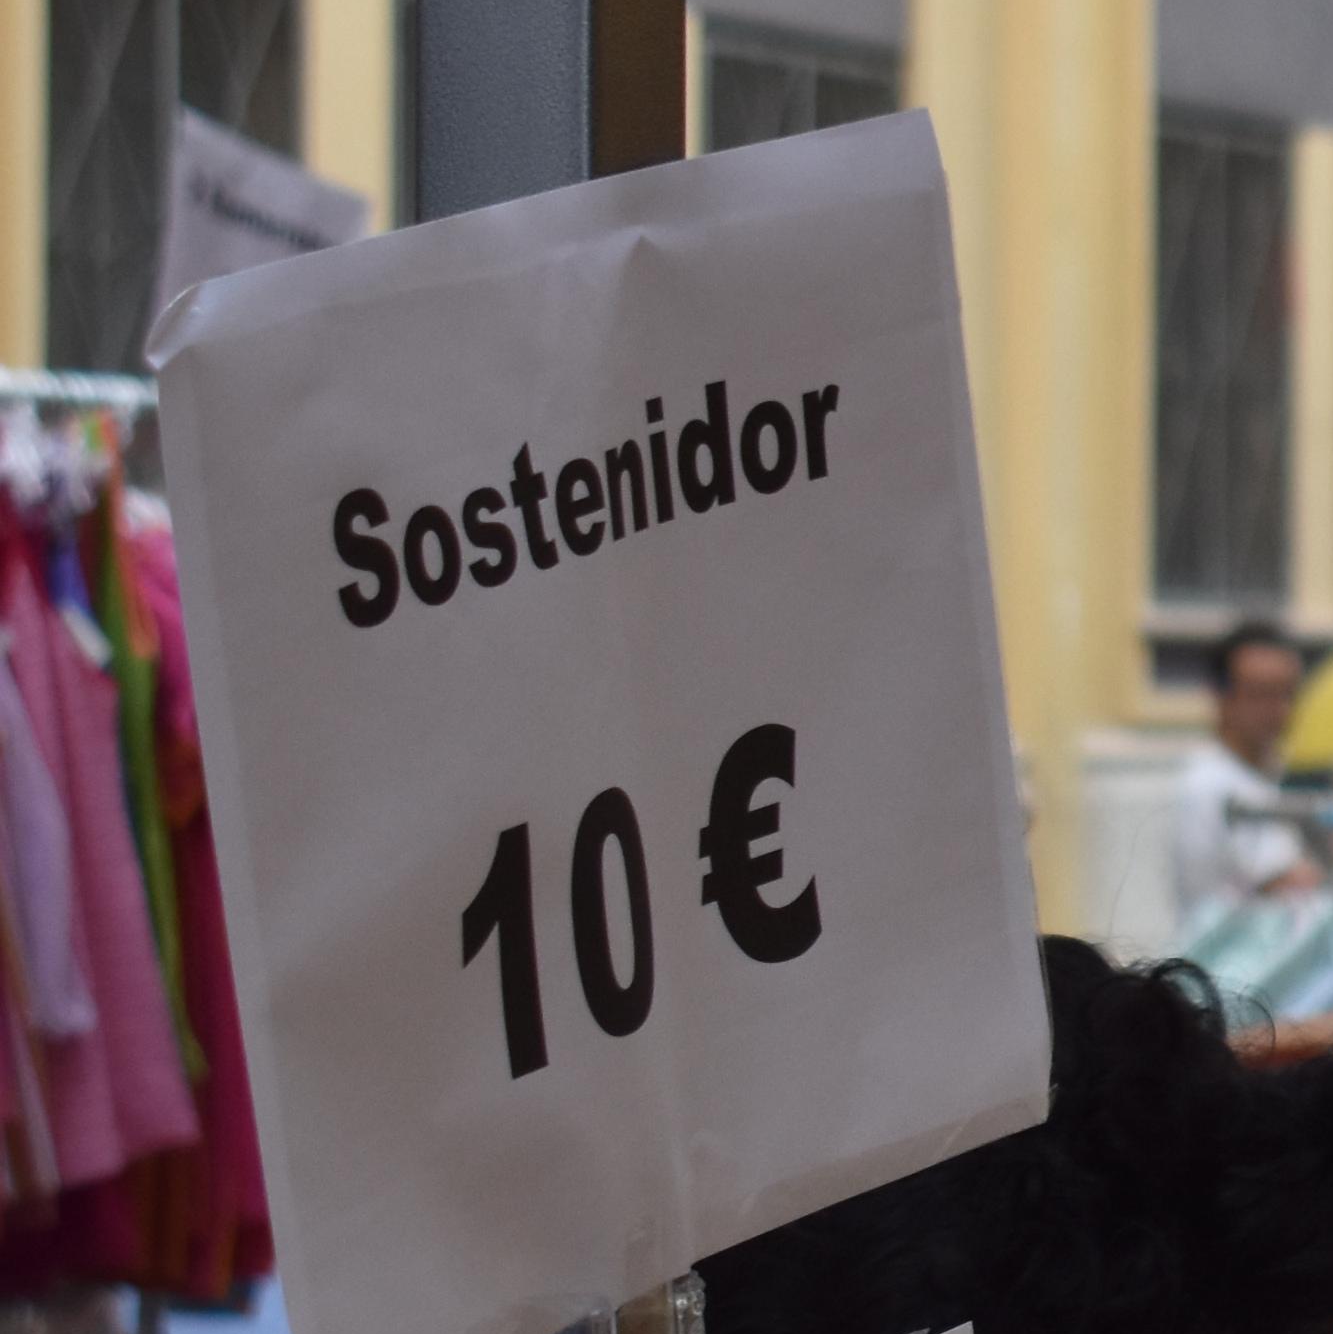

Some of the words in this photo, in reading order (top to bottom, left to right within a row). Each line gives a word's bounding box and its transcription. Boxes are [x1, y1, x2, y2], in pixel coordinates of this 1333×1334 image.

[332, 379, 840, 630] Sostenidor
[460, 785, 655, 1081] 10
[698, 722, 822, 965] €
